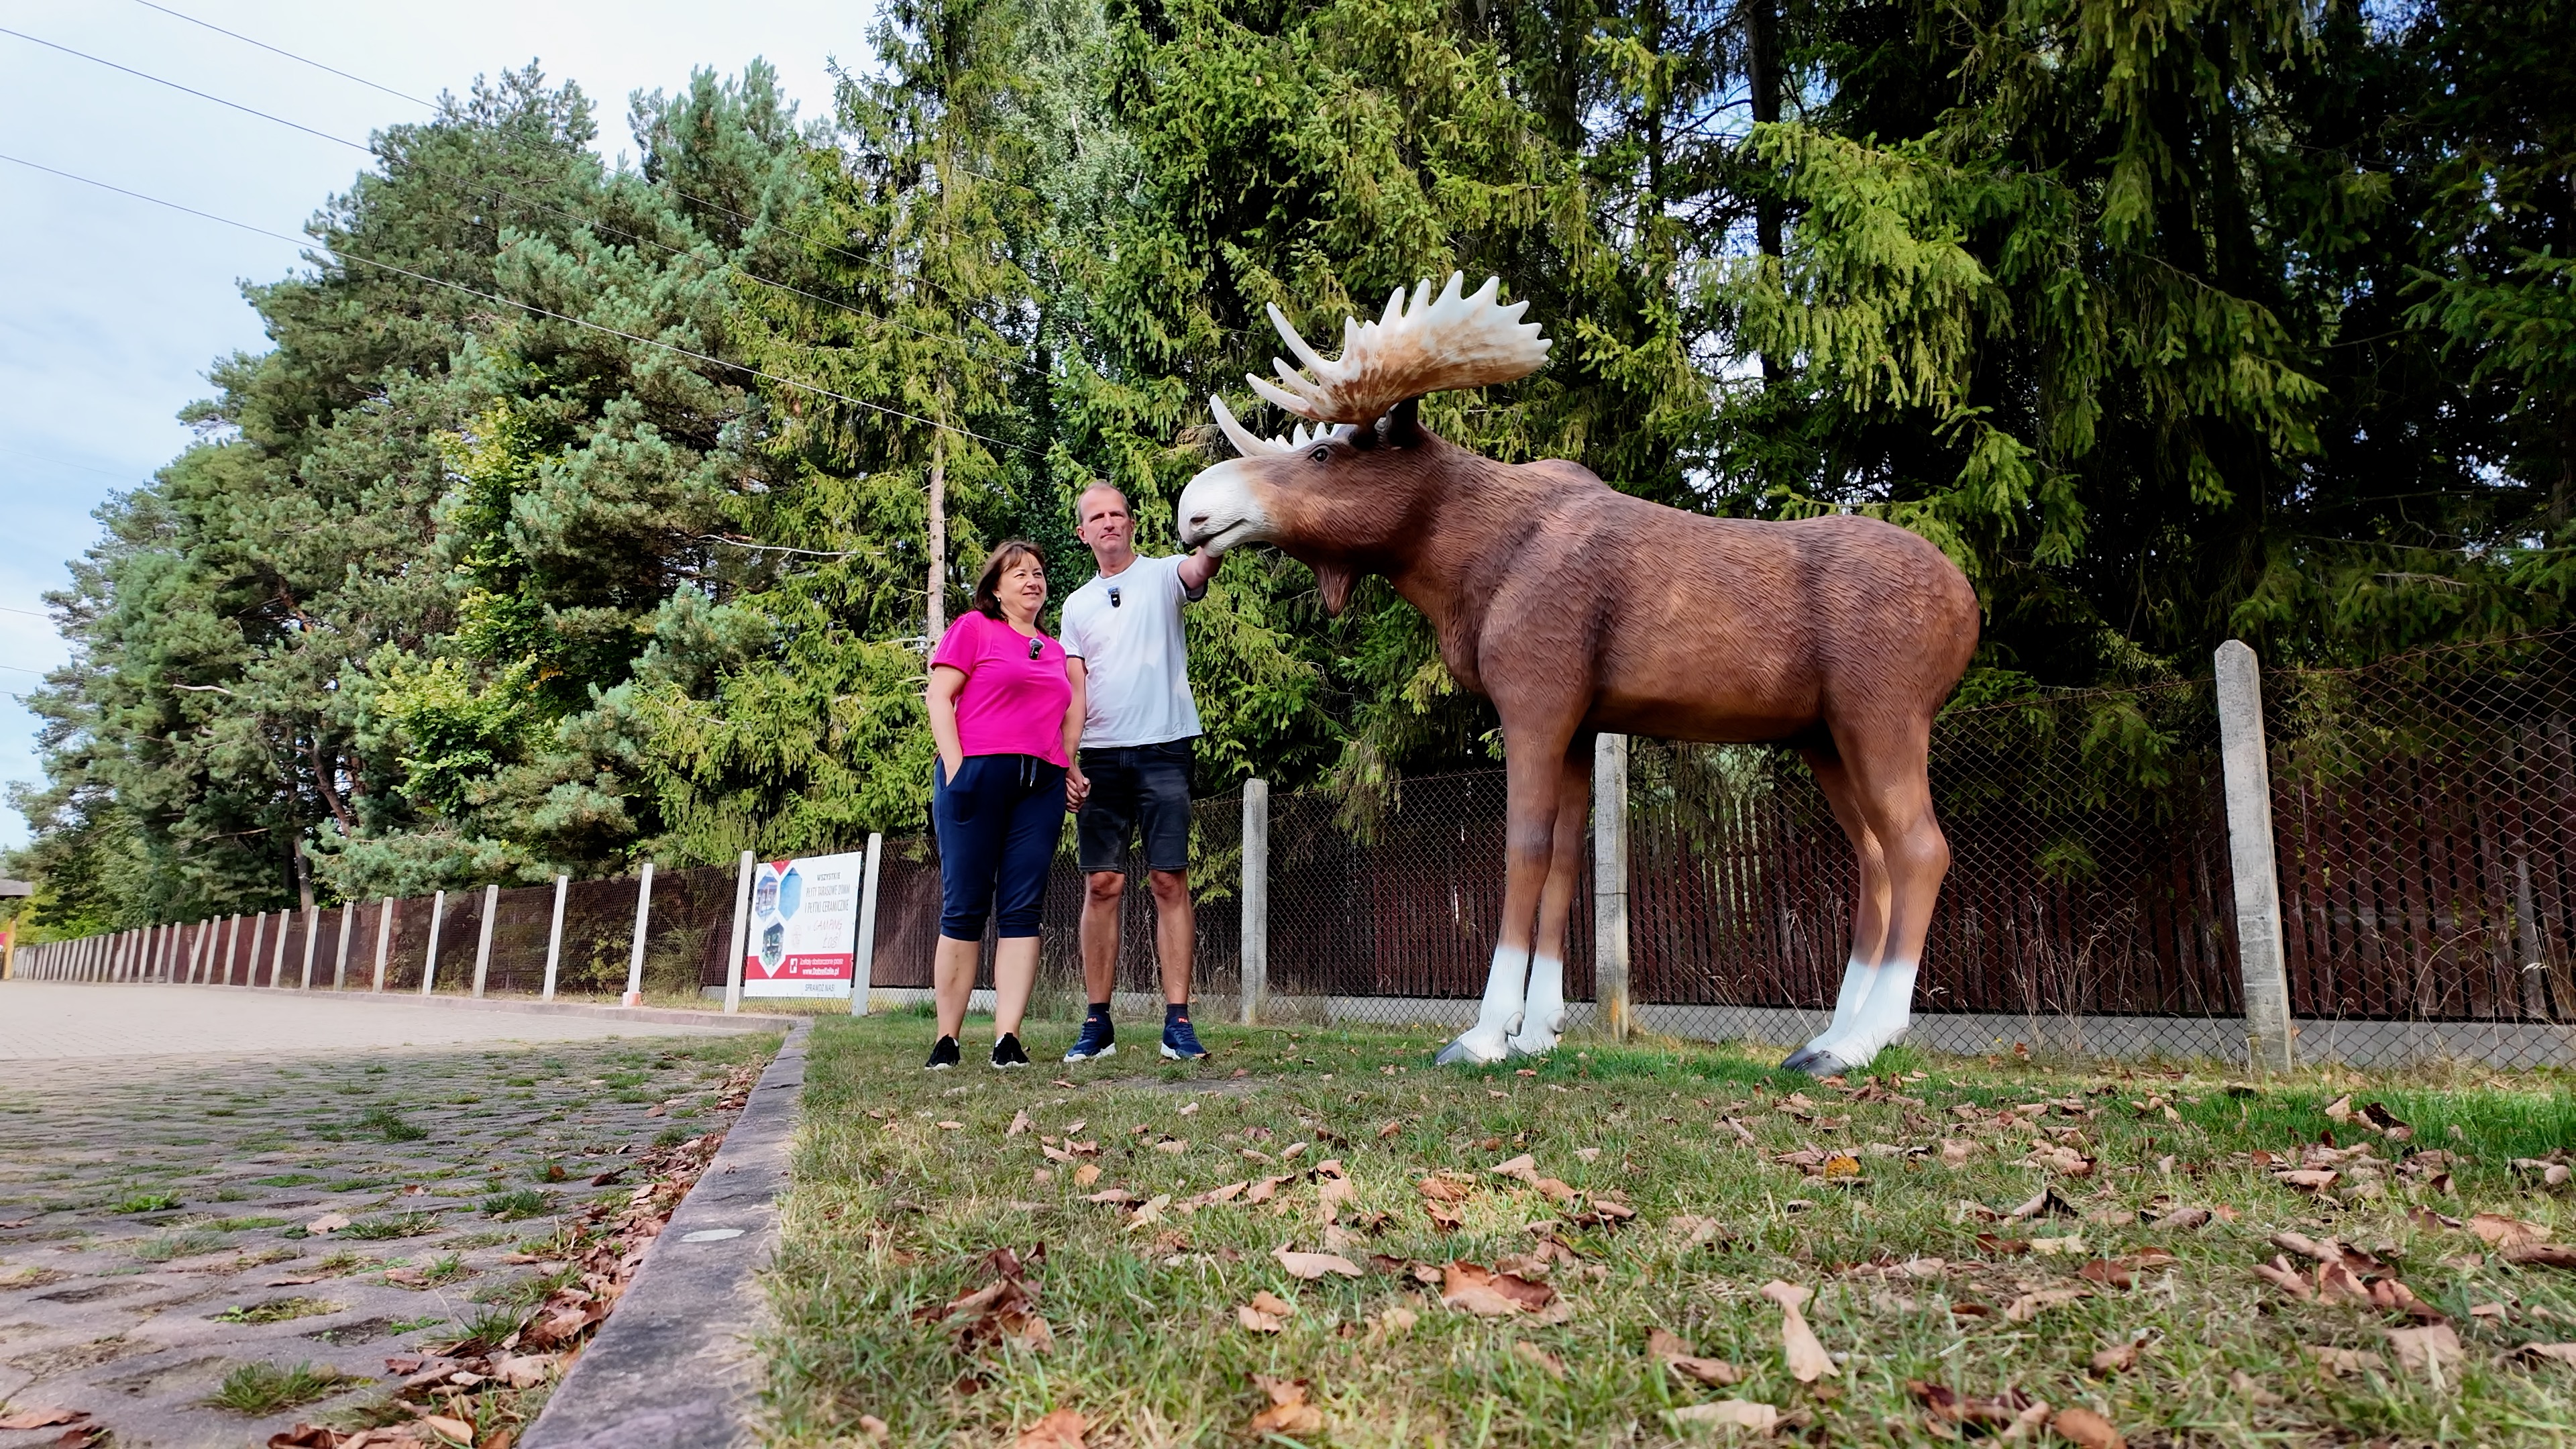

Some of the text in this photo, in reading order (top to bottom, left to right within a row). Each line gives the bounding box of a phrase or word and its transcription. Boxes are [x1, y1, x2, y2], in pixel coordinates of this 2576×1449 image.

[816, 872, 841, 881] WSZYSTKIE
[818, 885, 838, 896] TARASOWE
[822, 899, 849, 912] CERAMICZNE
